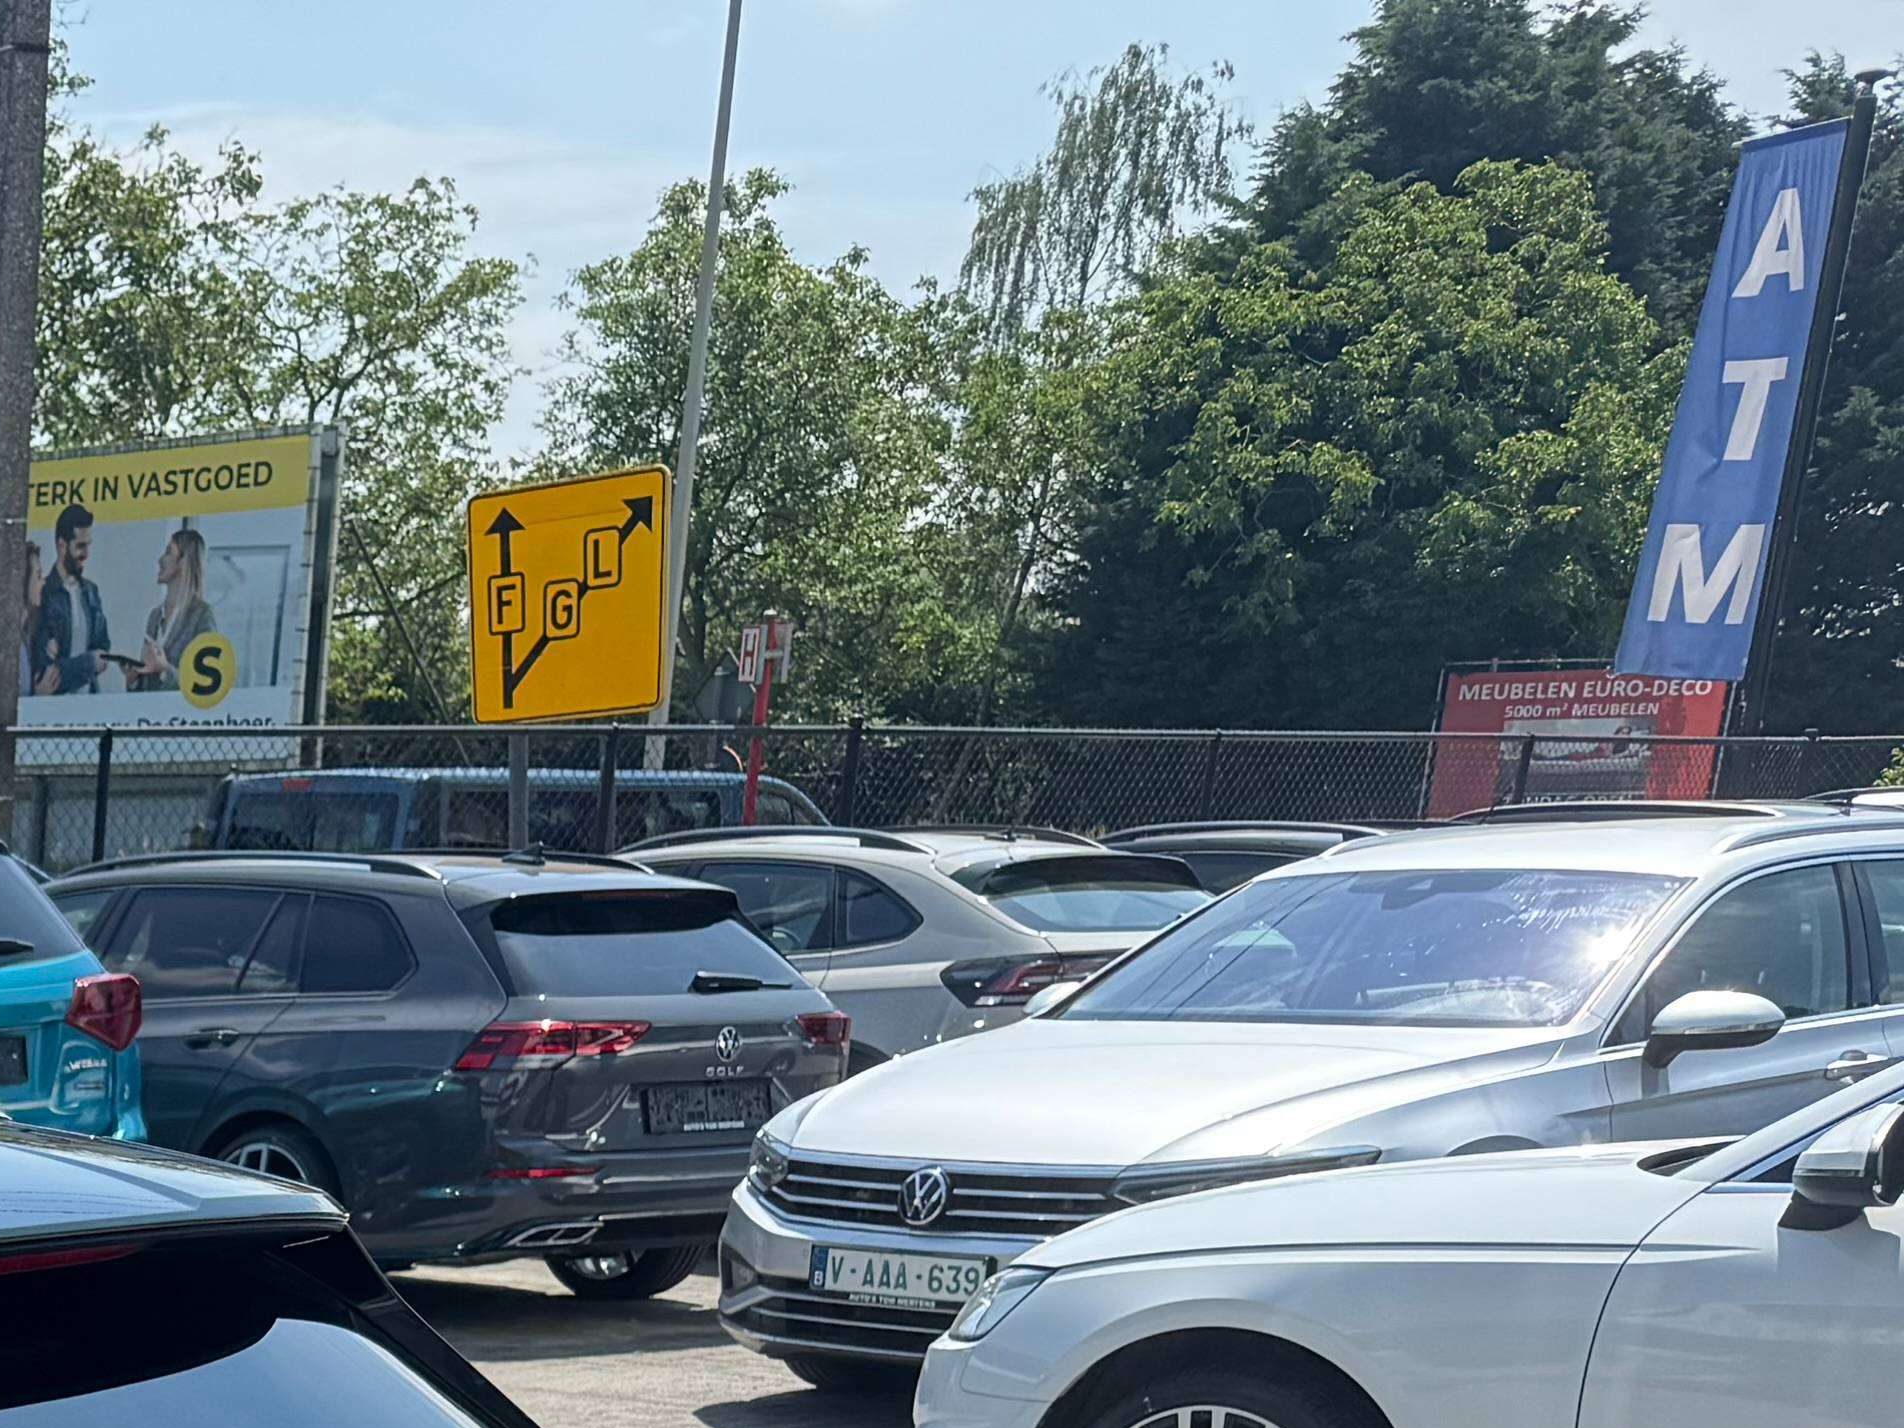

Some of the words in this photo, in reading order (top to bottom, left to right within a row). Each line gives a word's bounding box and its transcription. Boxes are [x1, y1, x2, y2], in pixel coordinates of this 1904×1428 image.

[1647, 187, 1805, 625] ATM
[93, 475, 119, 502] IN
[128, 460, 273, 498] VASTGOED
[593, 538, 613, 580] L
[496, 584, 517, 625] F
[551, 589, 573, 630] G
[192, 646, 222, 696] S
[1458, 681, 1576, 701] MEUBELEN
[1583, 679, 1713, 699] EURO-DECO
[1504, 705, 1542, 718] 5000
[1572, 702, 1660, 718] MEUBELEN
[705, 1065, 744, 1077] GOLF
